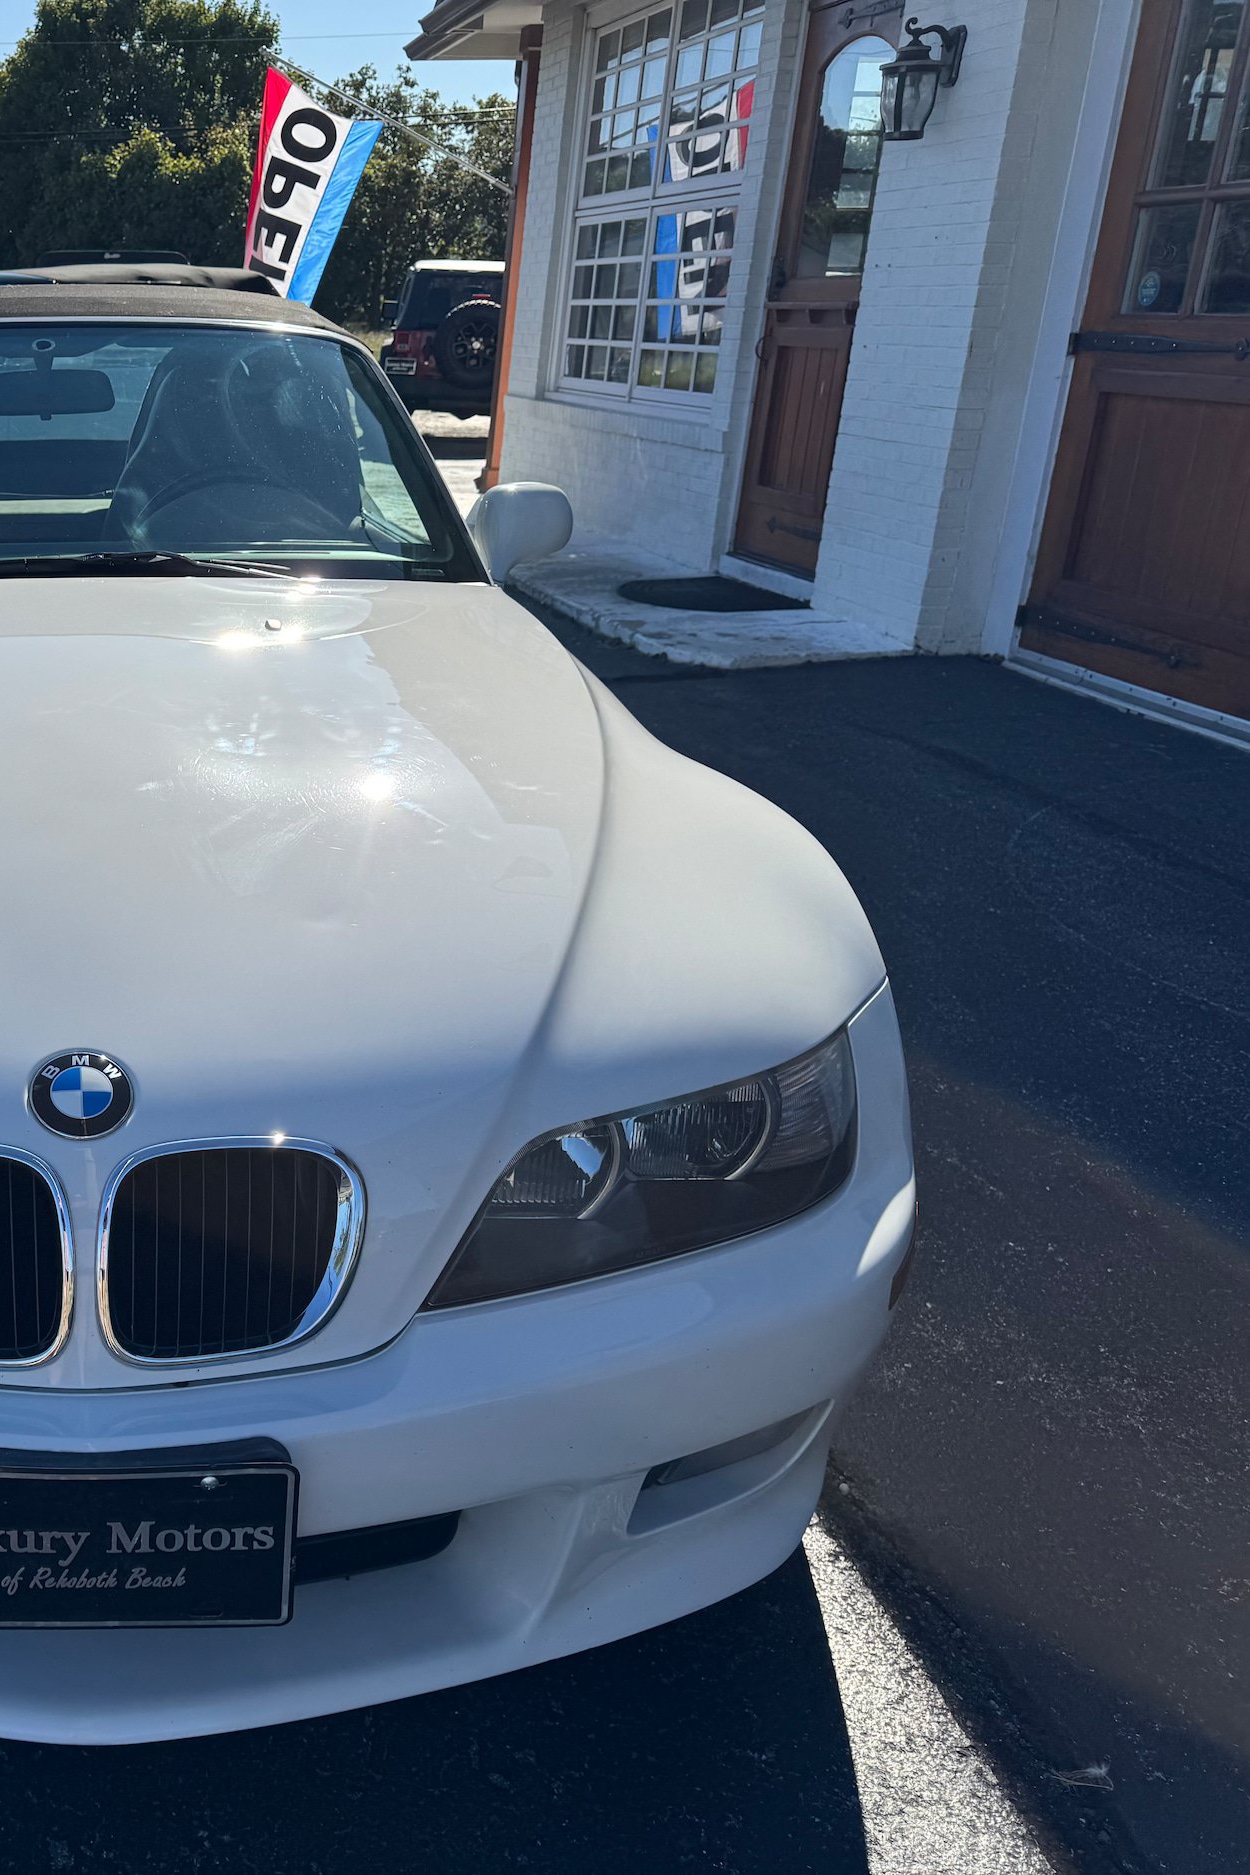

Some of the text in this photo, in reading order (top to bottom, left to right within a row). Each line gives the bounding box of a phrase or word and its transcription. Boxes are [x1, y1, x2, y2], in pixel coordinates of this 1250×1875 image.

[41, 1055, 122, 1080] BMW
[106, 1520, 275, 1555] Motors
[0, 1567, 186, 1595] of Rehoboth Beach
